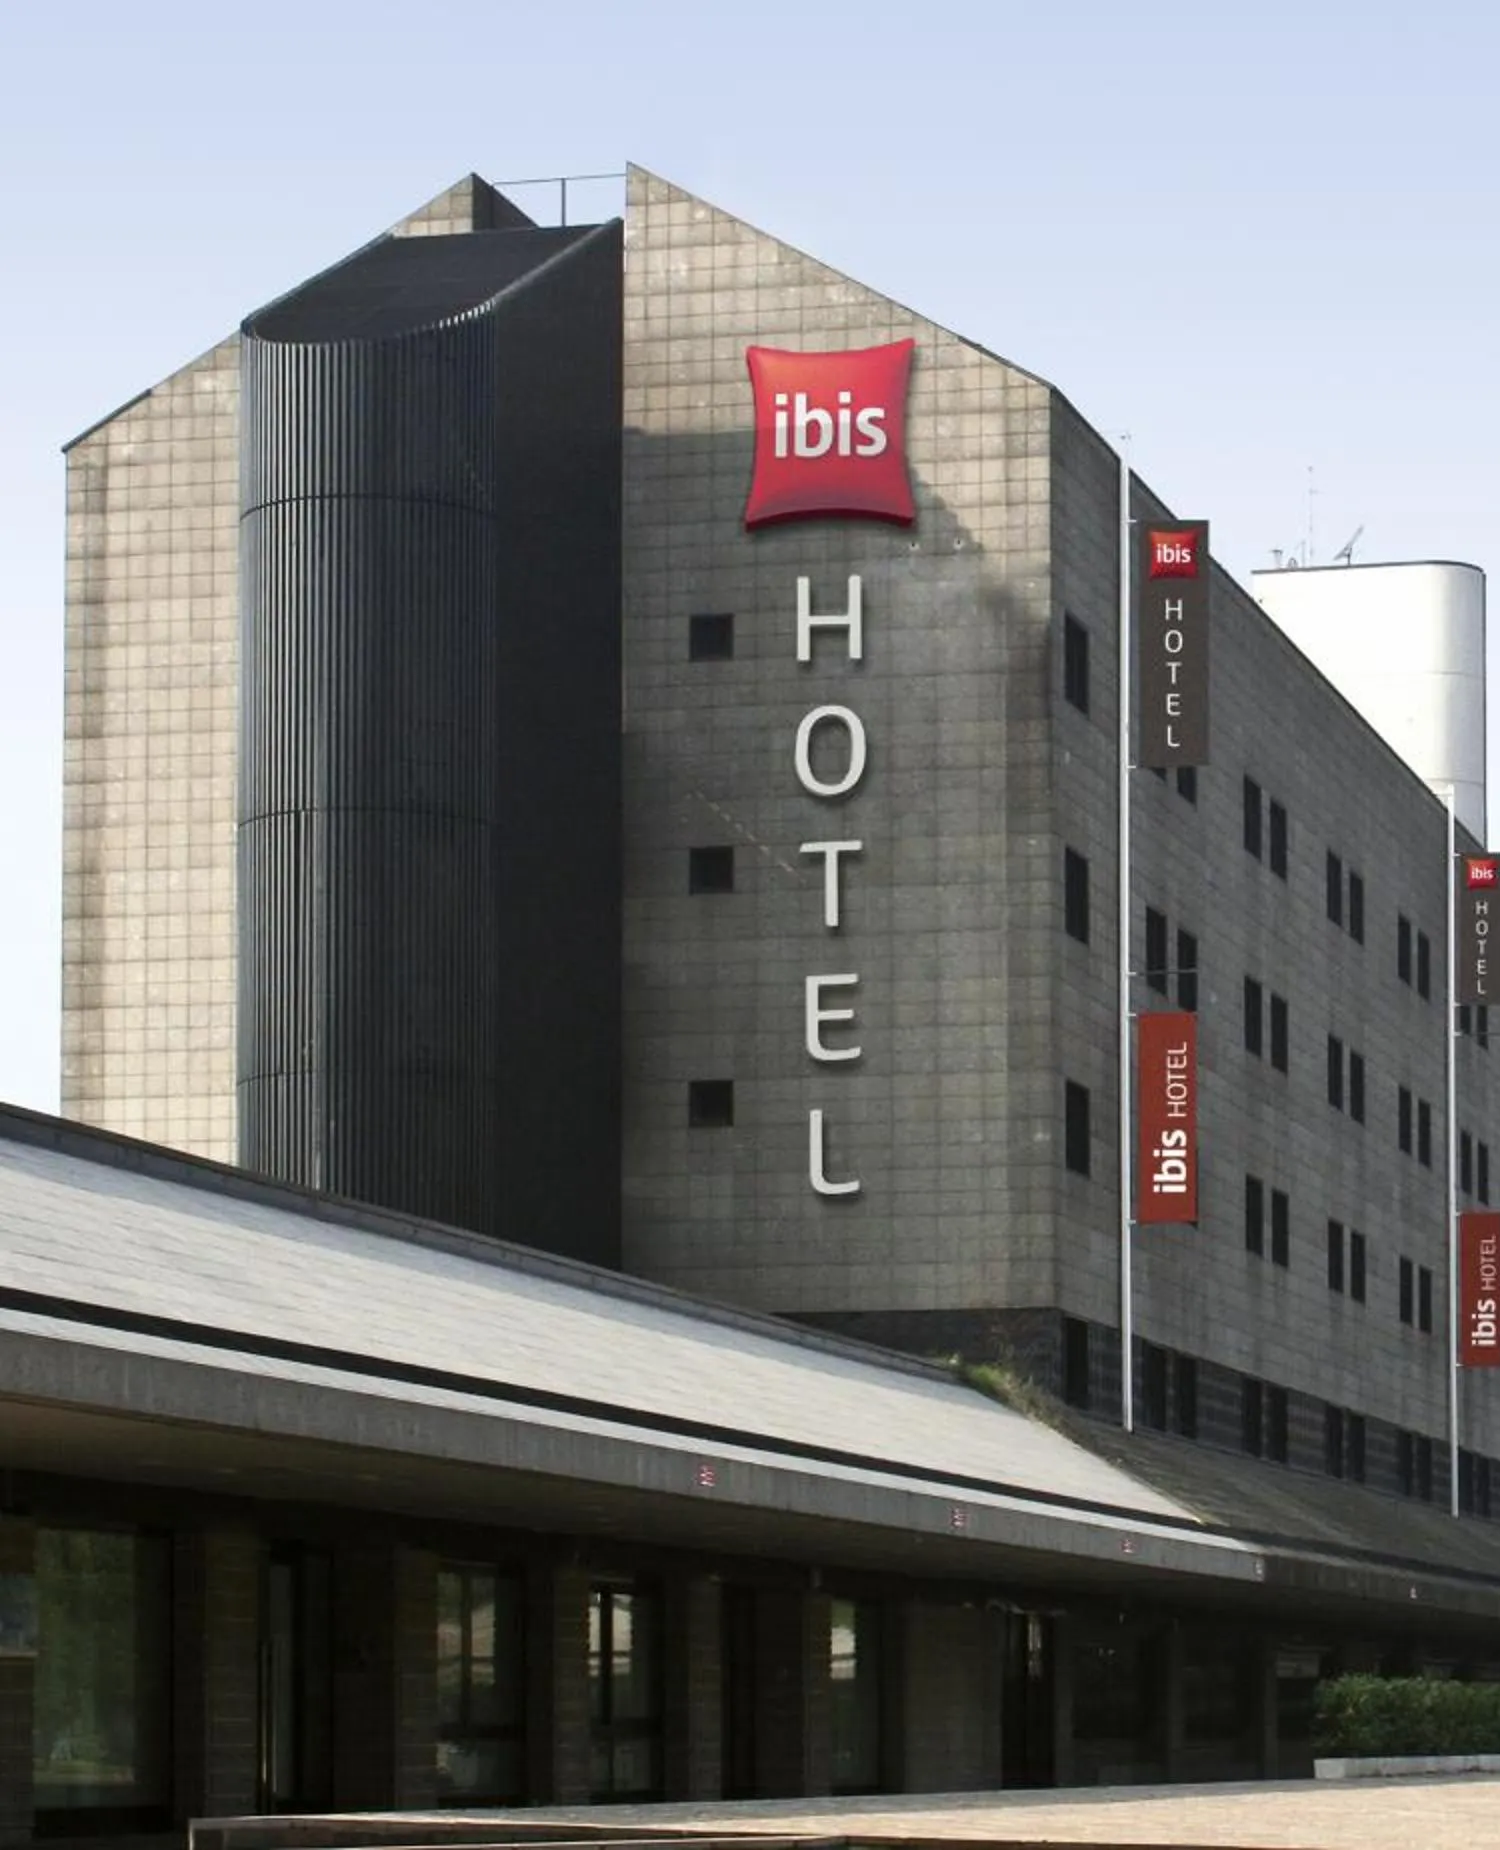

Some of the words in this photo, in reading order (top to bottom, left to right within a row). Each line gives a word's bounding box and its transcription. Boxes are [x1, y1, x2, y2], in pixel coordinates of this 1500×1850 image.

[775, 391, 887, 458] ibis
[1156, 544, 1191, 563] ibis
[1164, 598, 1183, 747] HOTEL
[795, 575, 867, 1196] HOTEL
[1471, 867, 1494, 880] ibis
[1475, 901, 1488, 994] HOTEL
[1166, 1041, 1187, 1117] HOTEL
[1153, 1129, 1187, 1193] ibis
[1480, 1235, 1497, 1291] HOTEL
[1471, 1298, 1497, 1347] ibis
